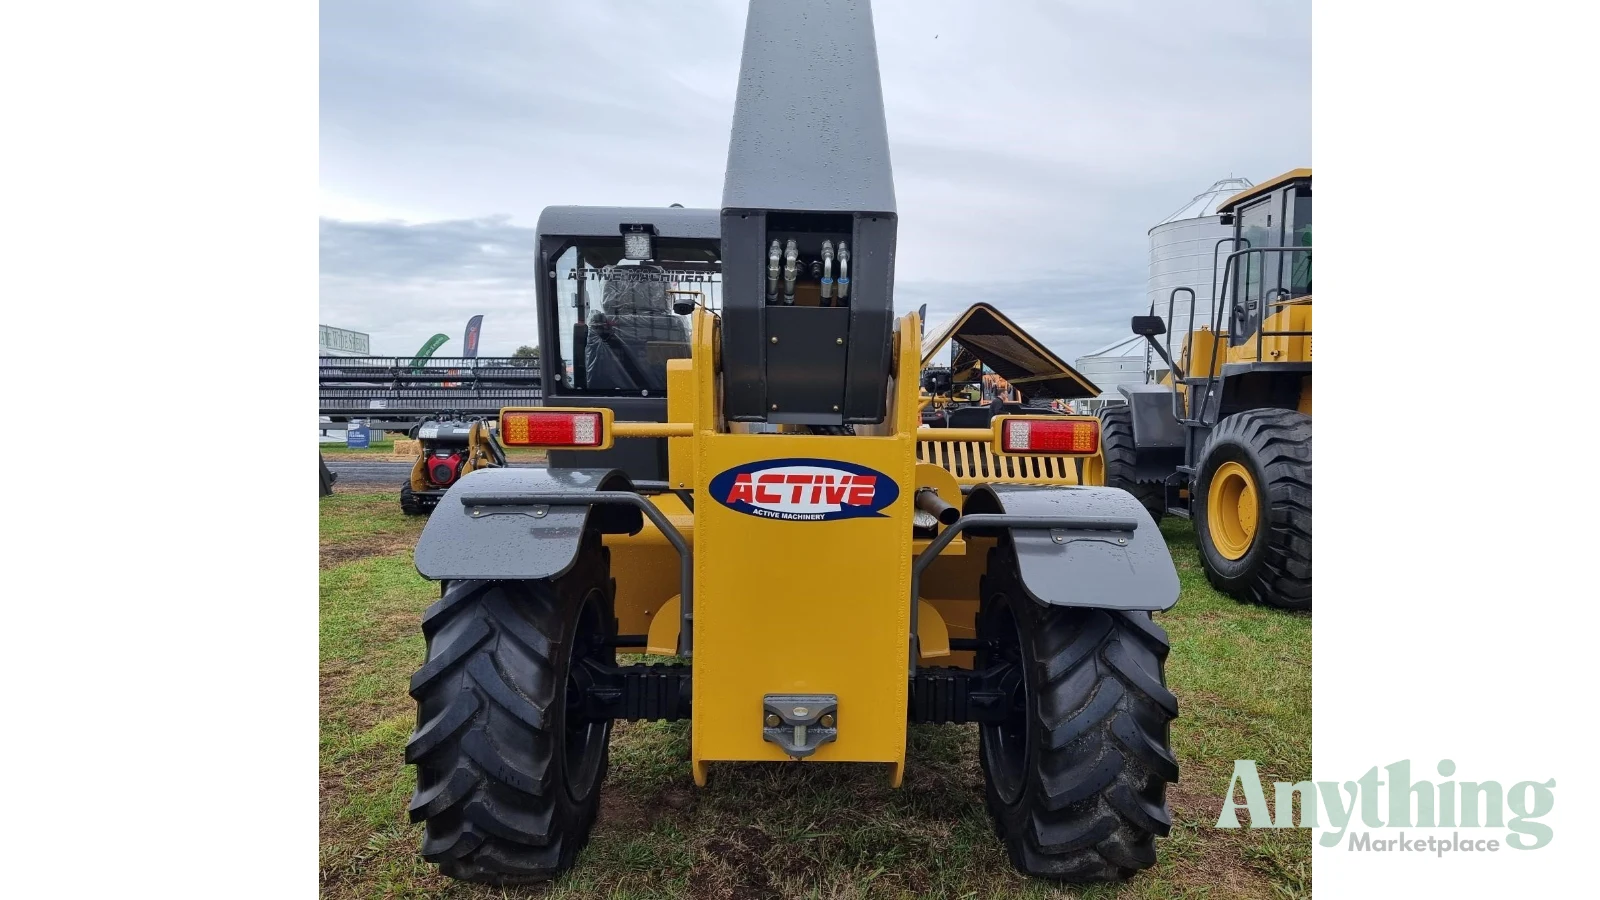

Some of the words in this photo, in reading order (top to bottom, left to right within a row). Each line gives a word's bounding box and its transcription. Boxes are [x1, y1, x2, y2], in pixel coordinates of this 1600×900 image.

[567, 268, 623, 281] ACTIVE
[628, 268, 715, 282] MACHINERY
[726, 473, 878, 506] ACTIVE
[752, 508, 780, 519] ACTIVE
[781, 512, 826, 521] MACHINERY
